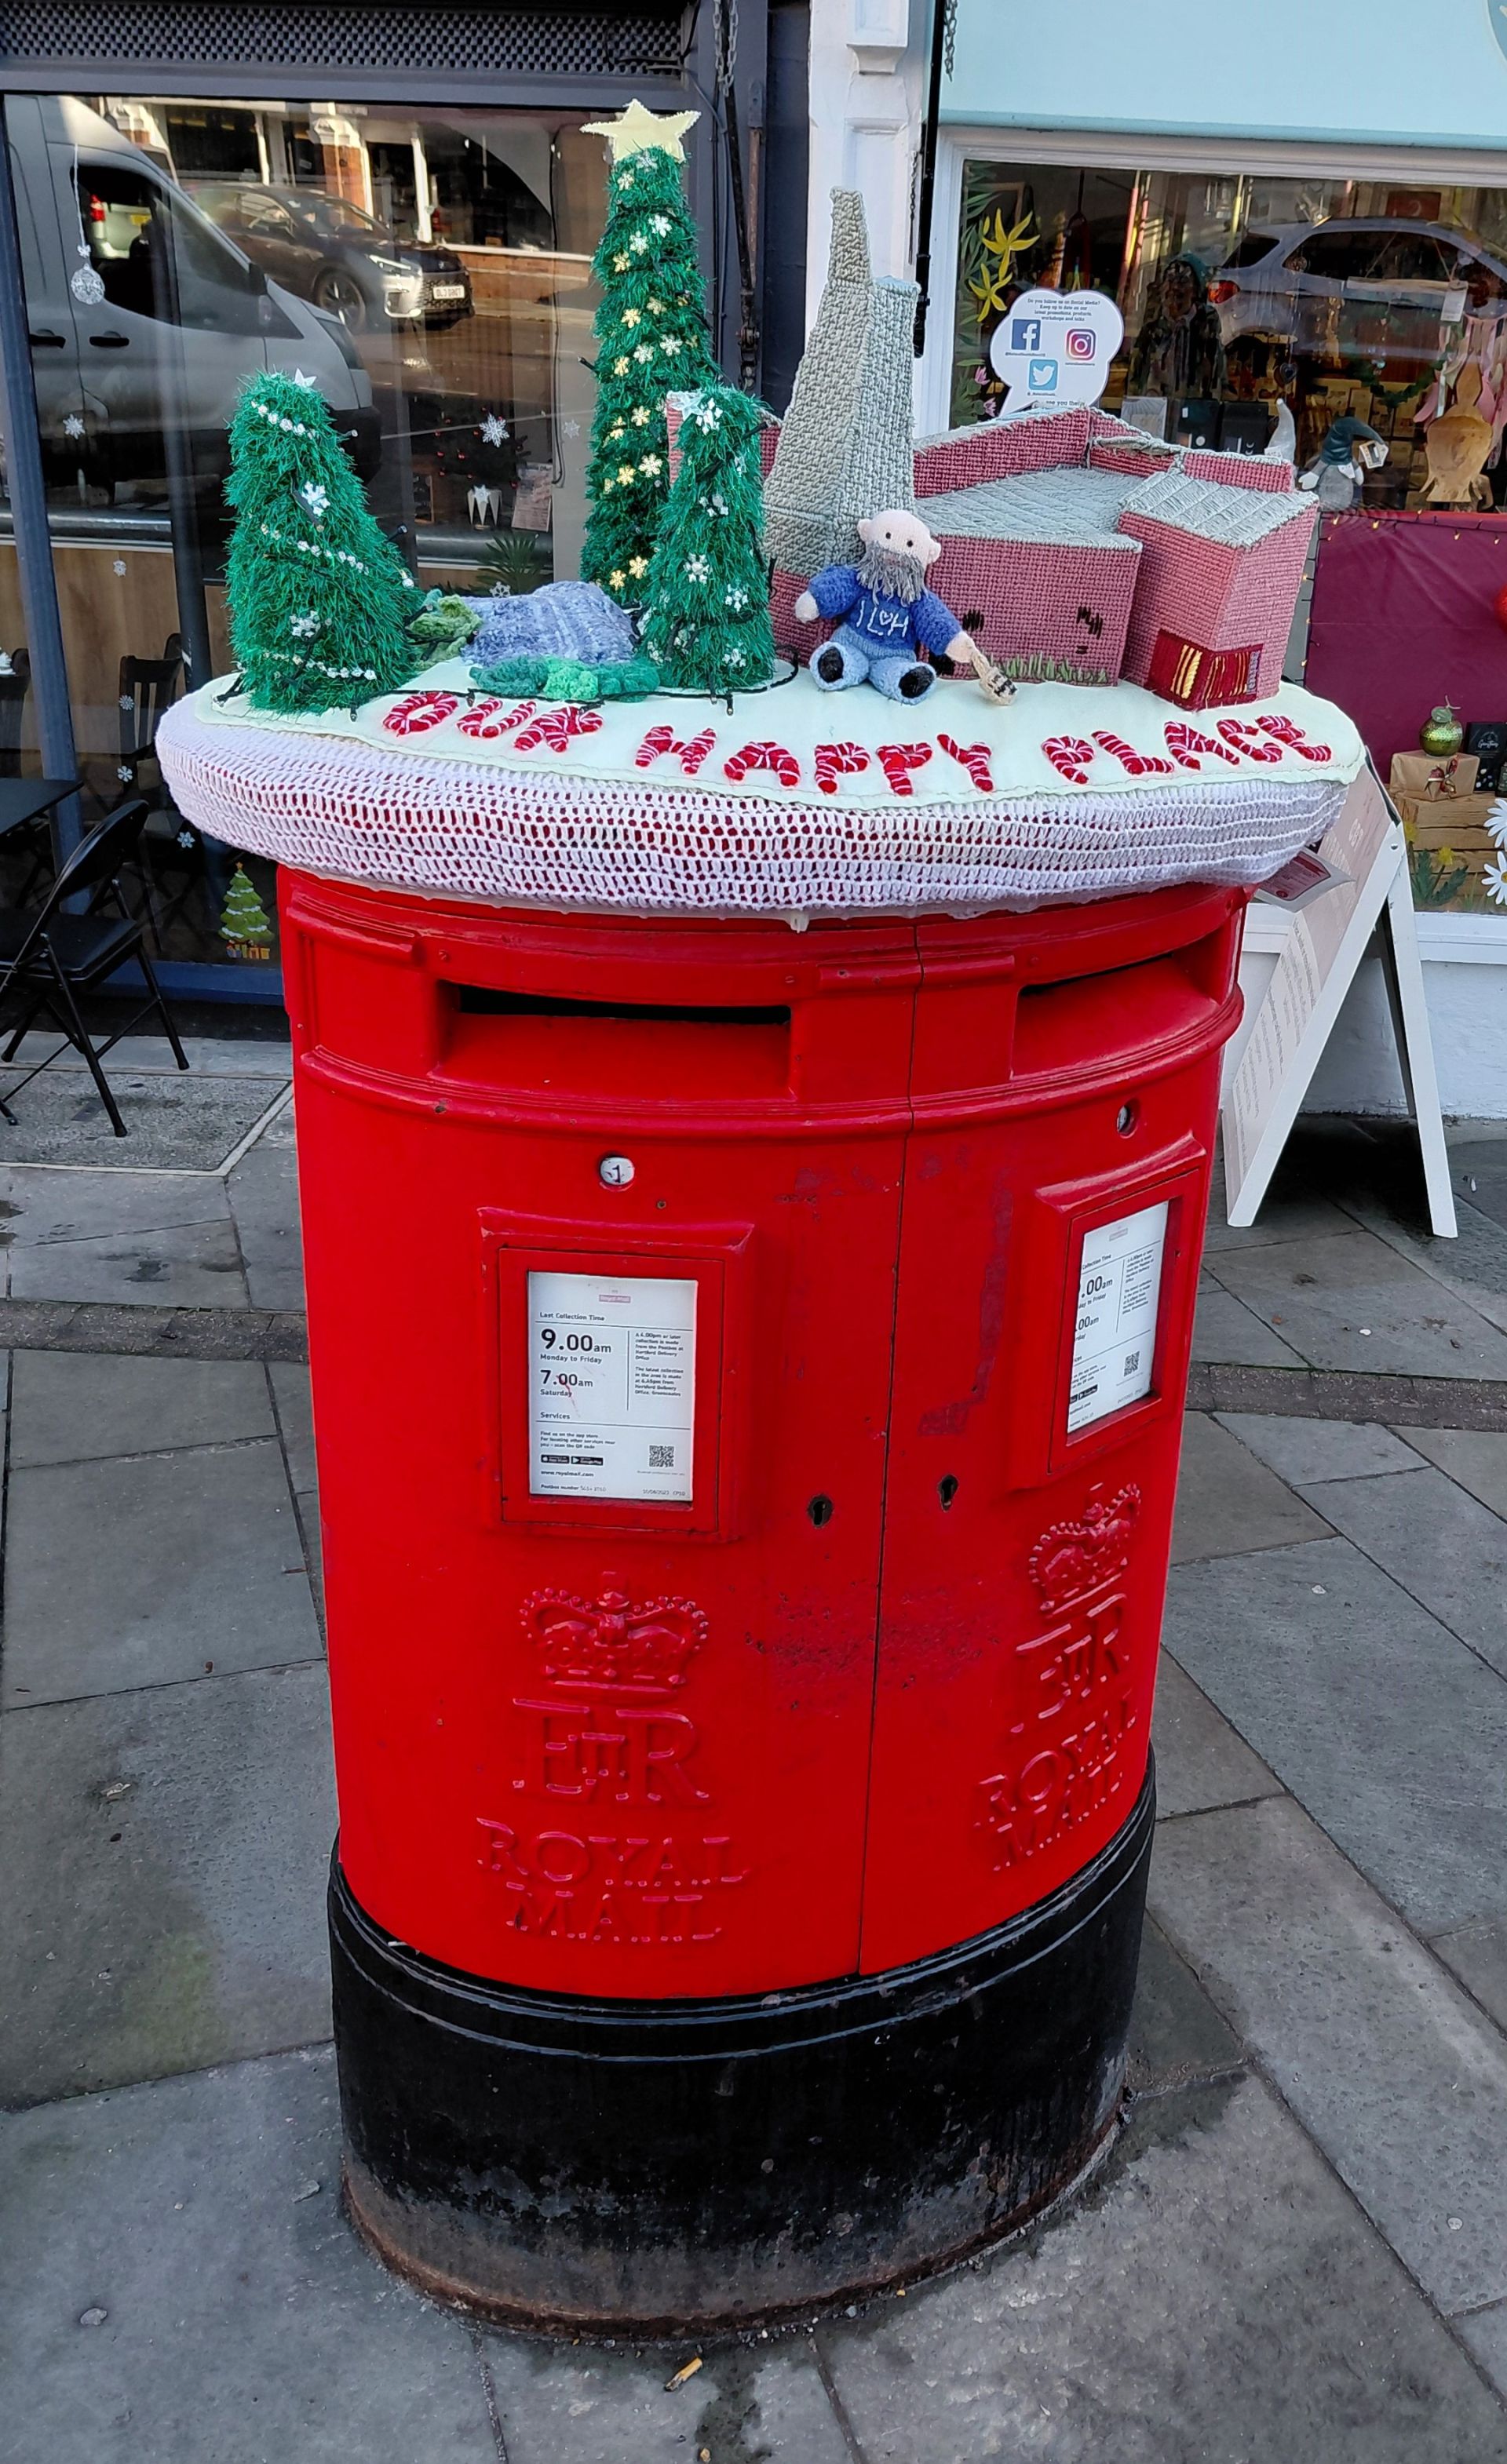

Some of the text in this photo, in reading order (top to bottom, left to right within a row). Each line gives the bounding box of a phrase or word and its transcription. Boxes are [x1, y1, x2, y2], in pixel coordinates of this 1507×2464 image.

[382, 692, 1333, 795] OUR HAPPY PLACE
[1093, 1293, 1106, 1302] Friday
[541, 1329, 611, 1353] 9.00am
[540, 1369, 593, 1387] 7.00am
[973, 1689, 1137, 1828] ROYAL
[476, 1817, 752, 1887] ROYAL
[506, 1882, 721, 1943] MAIL
